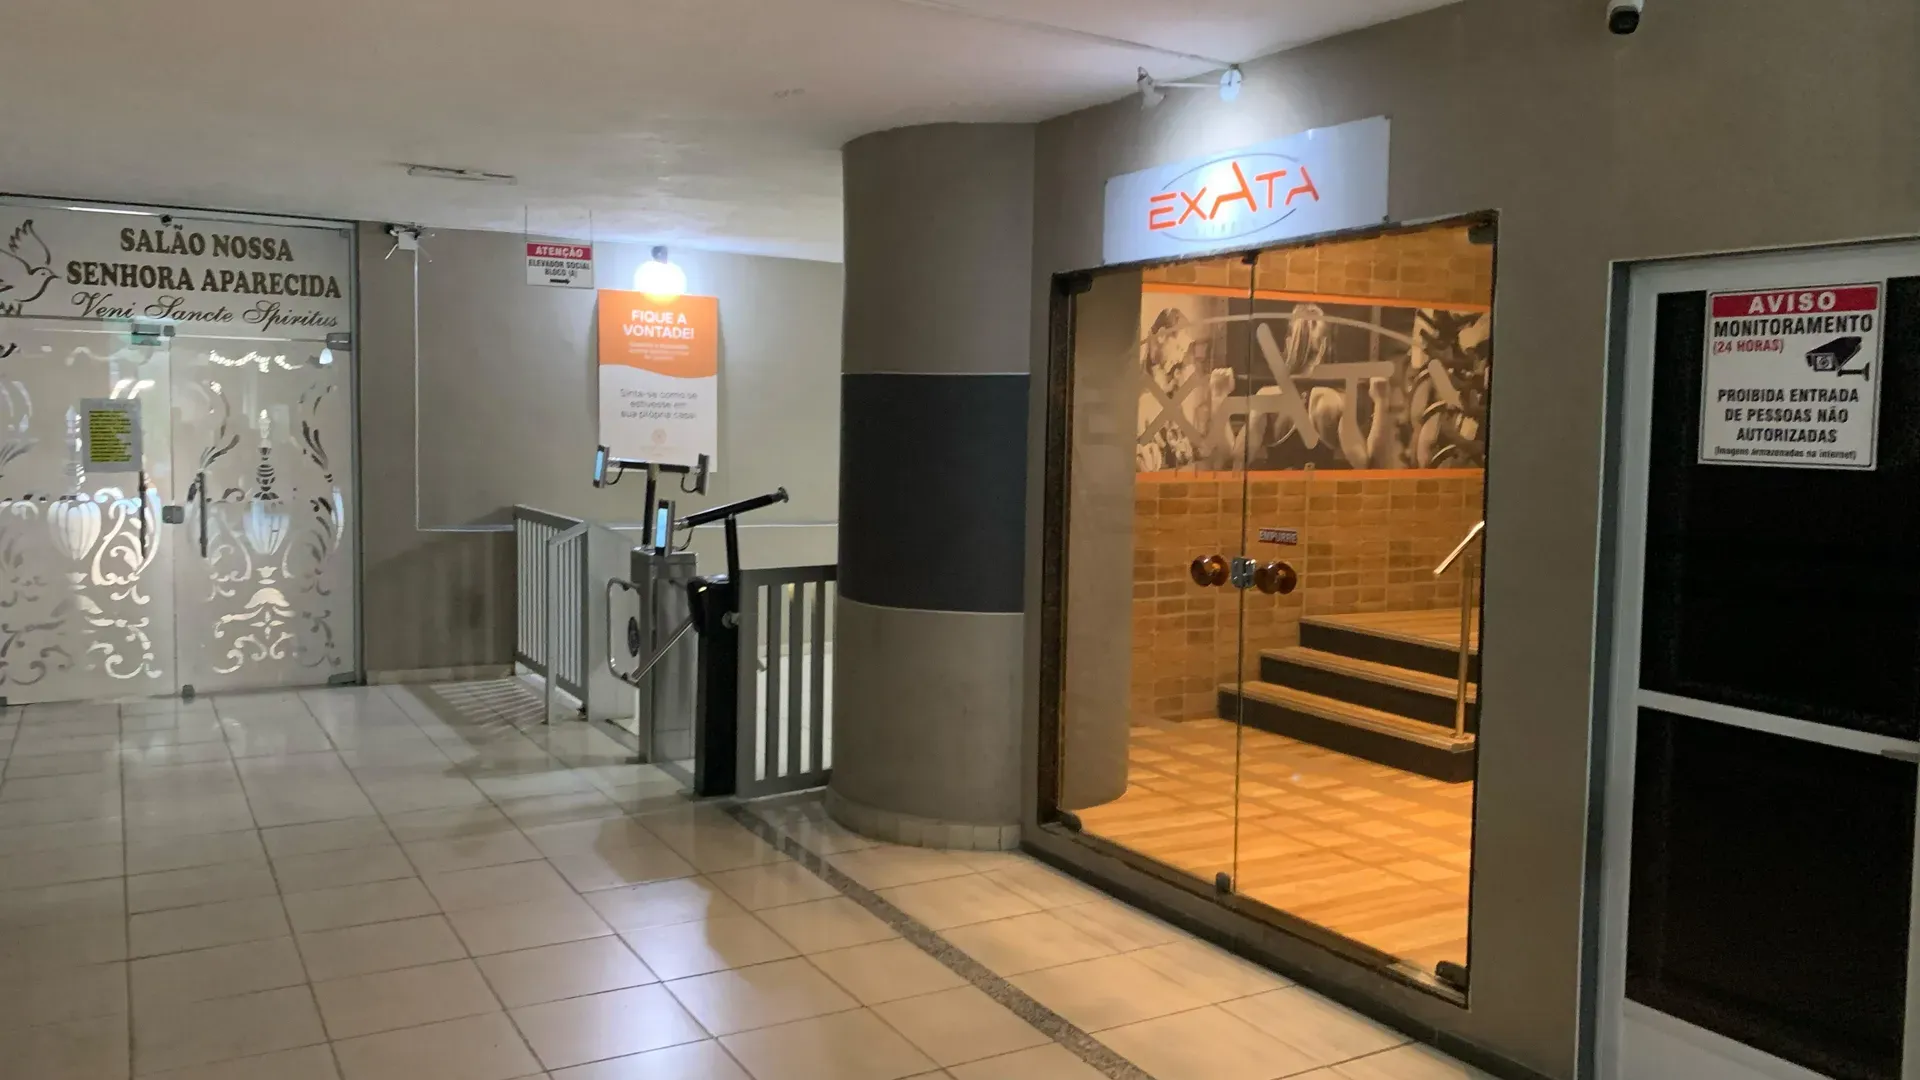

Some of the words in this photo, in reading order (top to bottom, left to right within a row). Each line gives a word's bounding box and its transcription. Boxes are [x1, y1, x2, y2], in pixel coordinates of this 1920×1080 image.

[1148, 161, 1320, 231] EXATA
[120, 224, 205, 257] SALÃO
[211, 233, 294, 262] NOSSA
[535, 245, 584, 259] ATENÇÃO
[528, 259, 564, 268] ELEVADOR
[566, 261, 590, 270] SOCIAL
[545, 268, 566, 277] BLOCO
[66, 260, 194, 292] SENHORA
[201, 269, 342, 299] APARECIDA
[1748, 291, 1836, 314] AVISO
[71, 291, 136, 319] Veni
[144, 295, 233, 325] Sancte
[242, 300, 338, 332] Spiritus
[631, 309, 674, 324] FIQUE
[677, 313, 687, 325] A
[623, 323, 695, 339] VONTADE!
[1713, 314, 1873, 338] MONITORAMENTO
[1713, 340, 1733, 356] (24
[1737, 338, 1785, 354] HORAS)
[620, 388, 657, 398] Sinta-se
[660, 391, 685, 399] como
[687, 392, 698, 400] se
[1717, 388, 1785, 402] PROIBIDA
[1789, 388, 1859, 402] ENTRADA
[1724, 408, 1742, 422] DE
[1747, 408, 1812, 423] PESSOAS
[1817, 405, 1849, 423] NÃO
[1736, 427, 1837, 443] AUTORIZADAS
